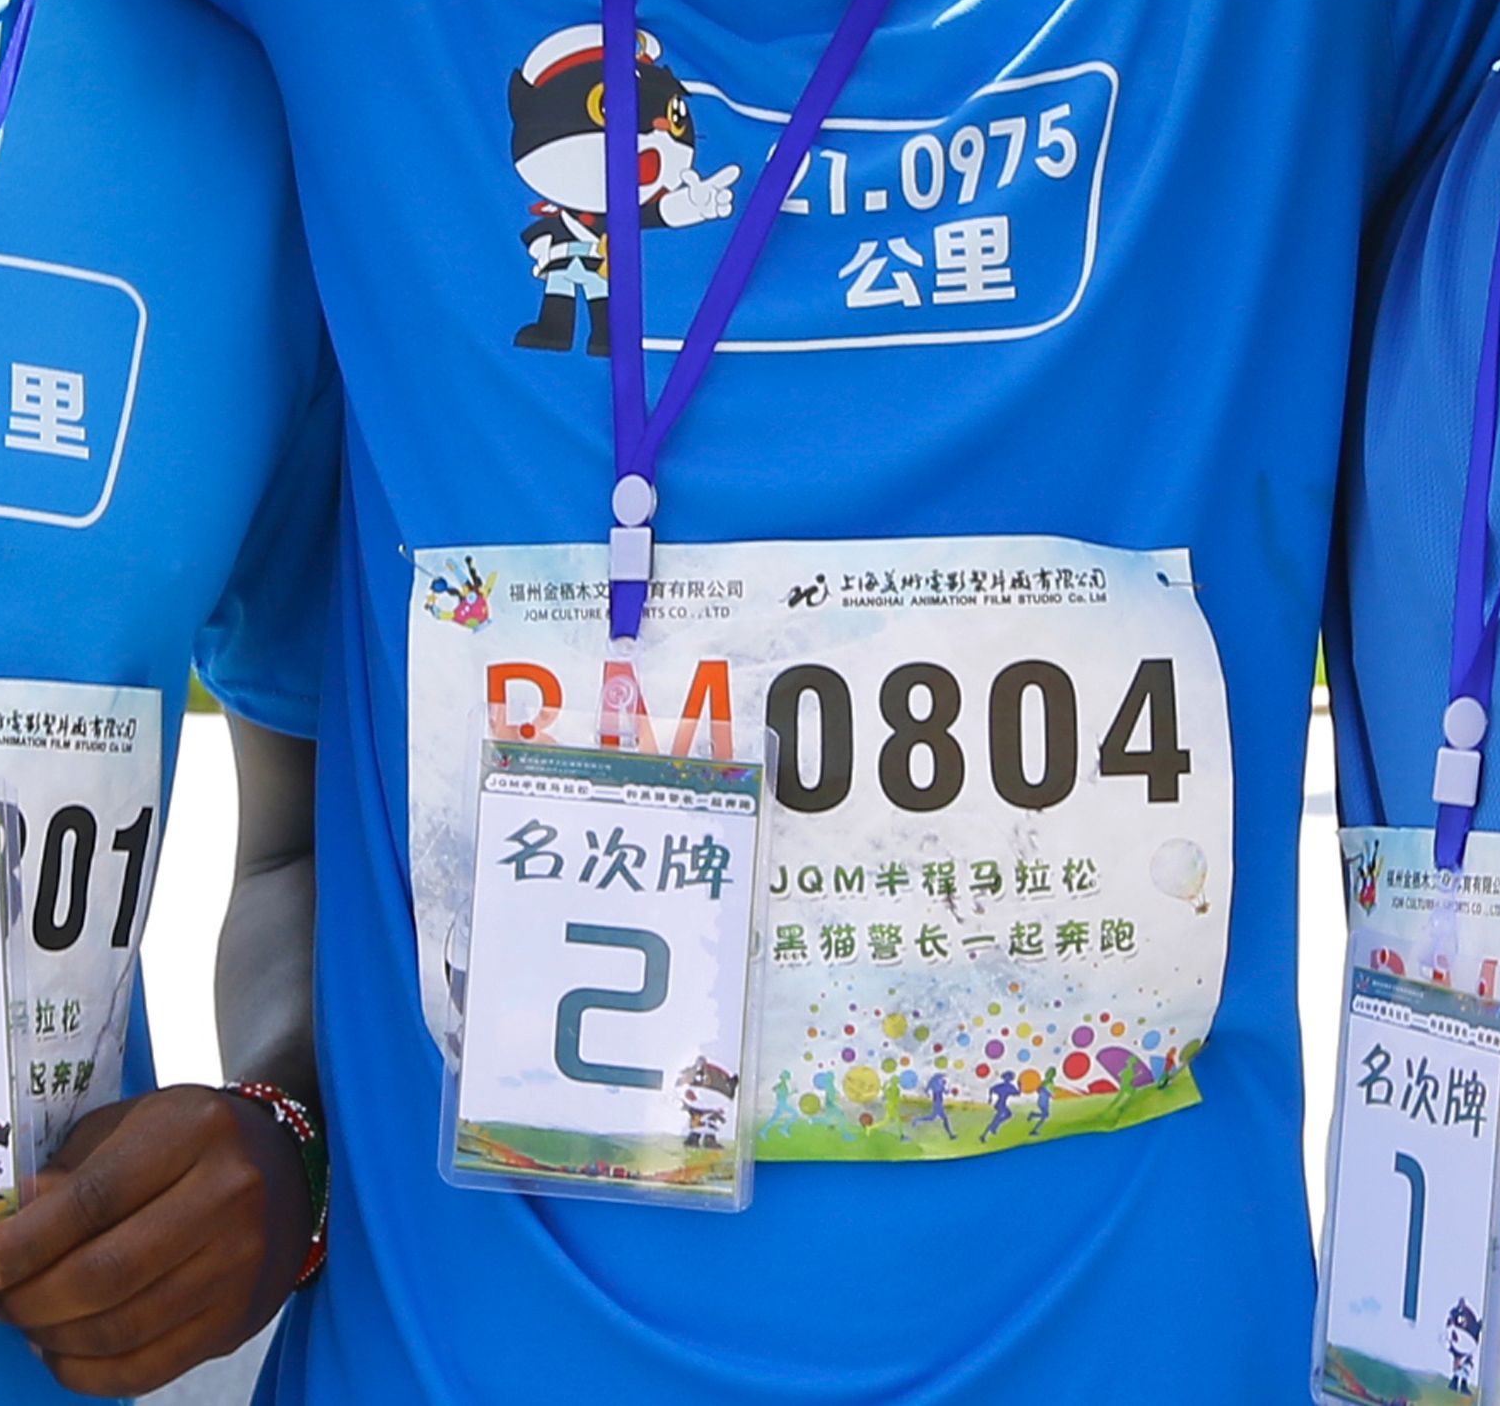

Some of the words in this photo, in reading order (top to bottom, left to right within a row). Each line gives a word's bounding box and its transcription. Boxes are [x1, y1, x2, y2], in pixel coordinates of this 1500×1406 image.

[837, 215, 1017, 309] 公里
[509, 579, 744, 603] 福州金栖木文育有限公司
[523, 607, 548, 621] JQM
[551, 606, 601, 620] CULTURE
[704, 606, 730, 619] LTD
[841, 596, 904, 607] SHANGHAI
[910, 595, 977, 606] ANIMATION
[983, 594, 1012, 605] FILM
[1018, 593, 1062, 604] STUDIO
[497, 818, 735, 900] 名次牌
[769, 857, 1098, 896] JQM半程马拉松
[752, 916, 1136, 962] 黑猫警长一起奔跑
[554, 921, 671, 1091] 2
[1356, 1042, 1488, 1138] 名次牌
[1394, 1150, 1426, 1322] 1
